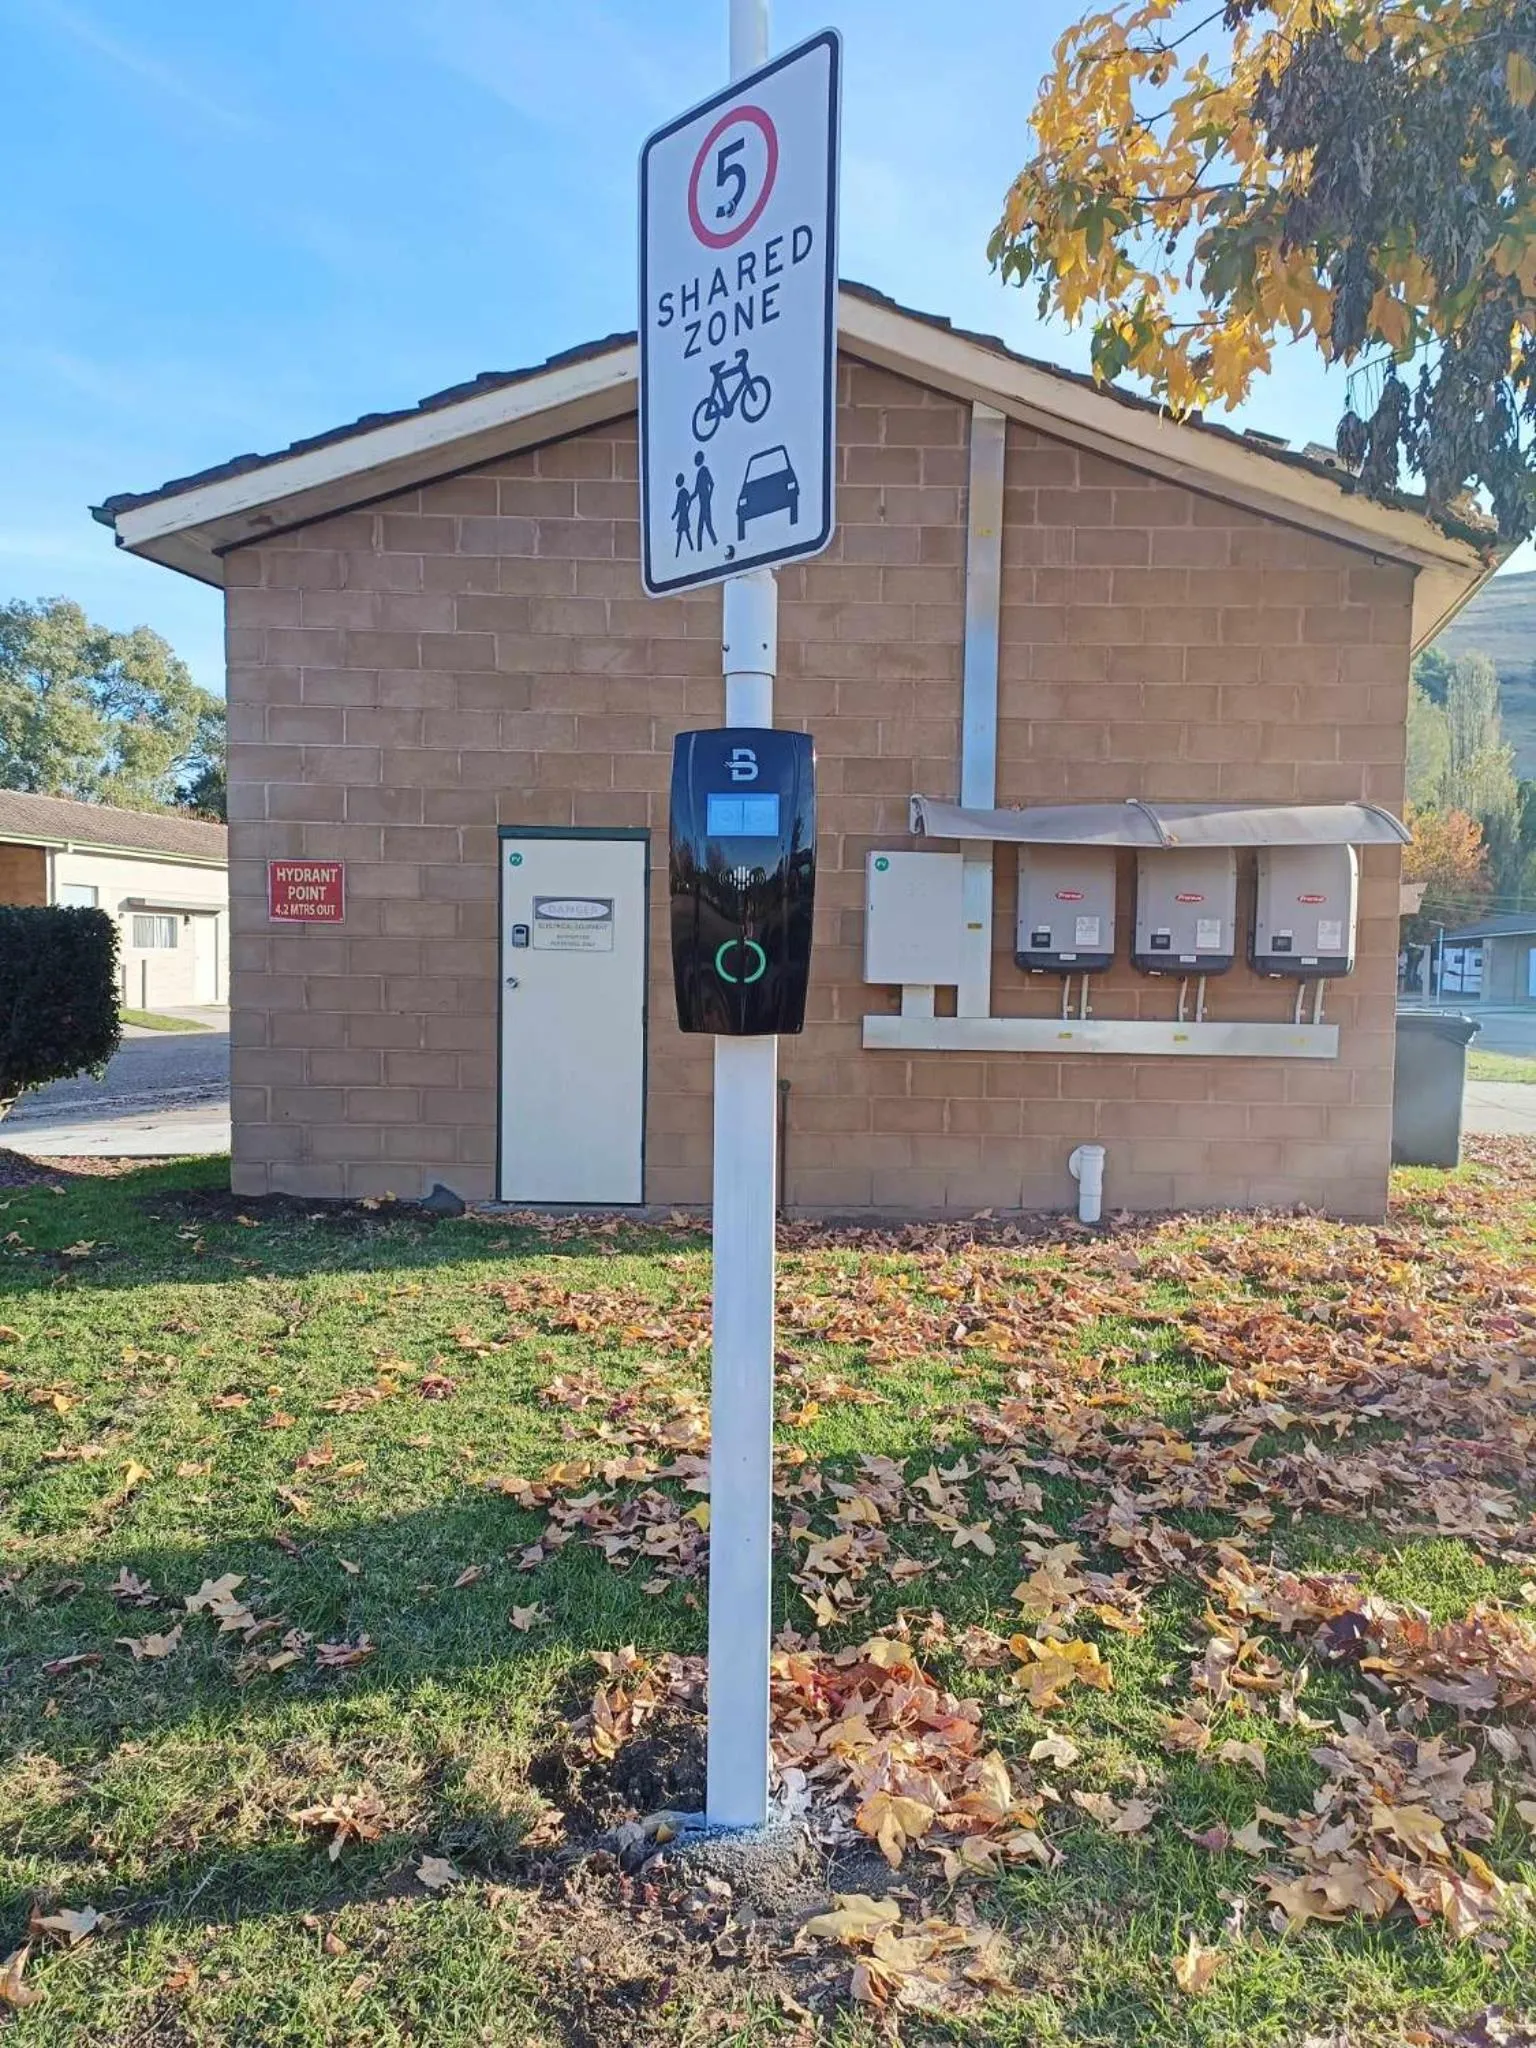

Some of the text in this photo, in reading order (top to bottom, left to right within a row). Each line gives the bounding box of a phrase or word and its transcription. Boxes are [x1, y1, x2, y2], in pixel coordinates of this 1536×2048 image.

[715, 137, 746, 218] 5
[657, 224, 813, 328] SHARED
[683, 283, 780, 359] ZONE
[276, 867, 338, 883] HYDRANT
[287, 886, 327, 901] POINT
[275, 903, 336, 916] 4.2 MTRS OUT
